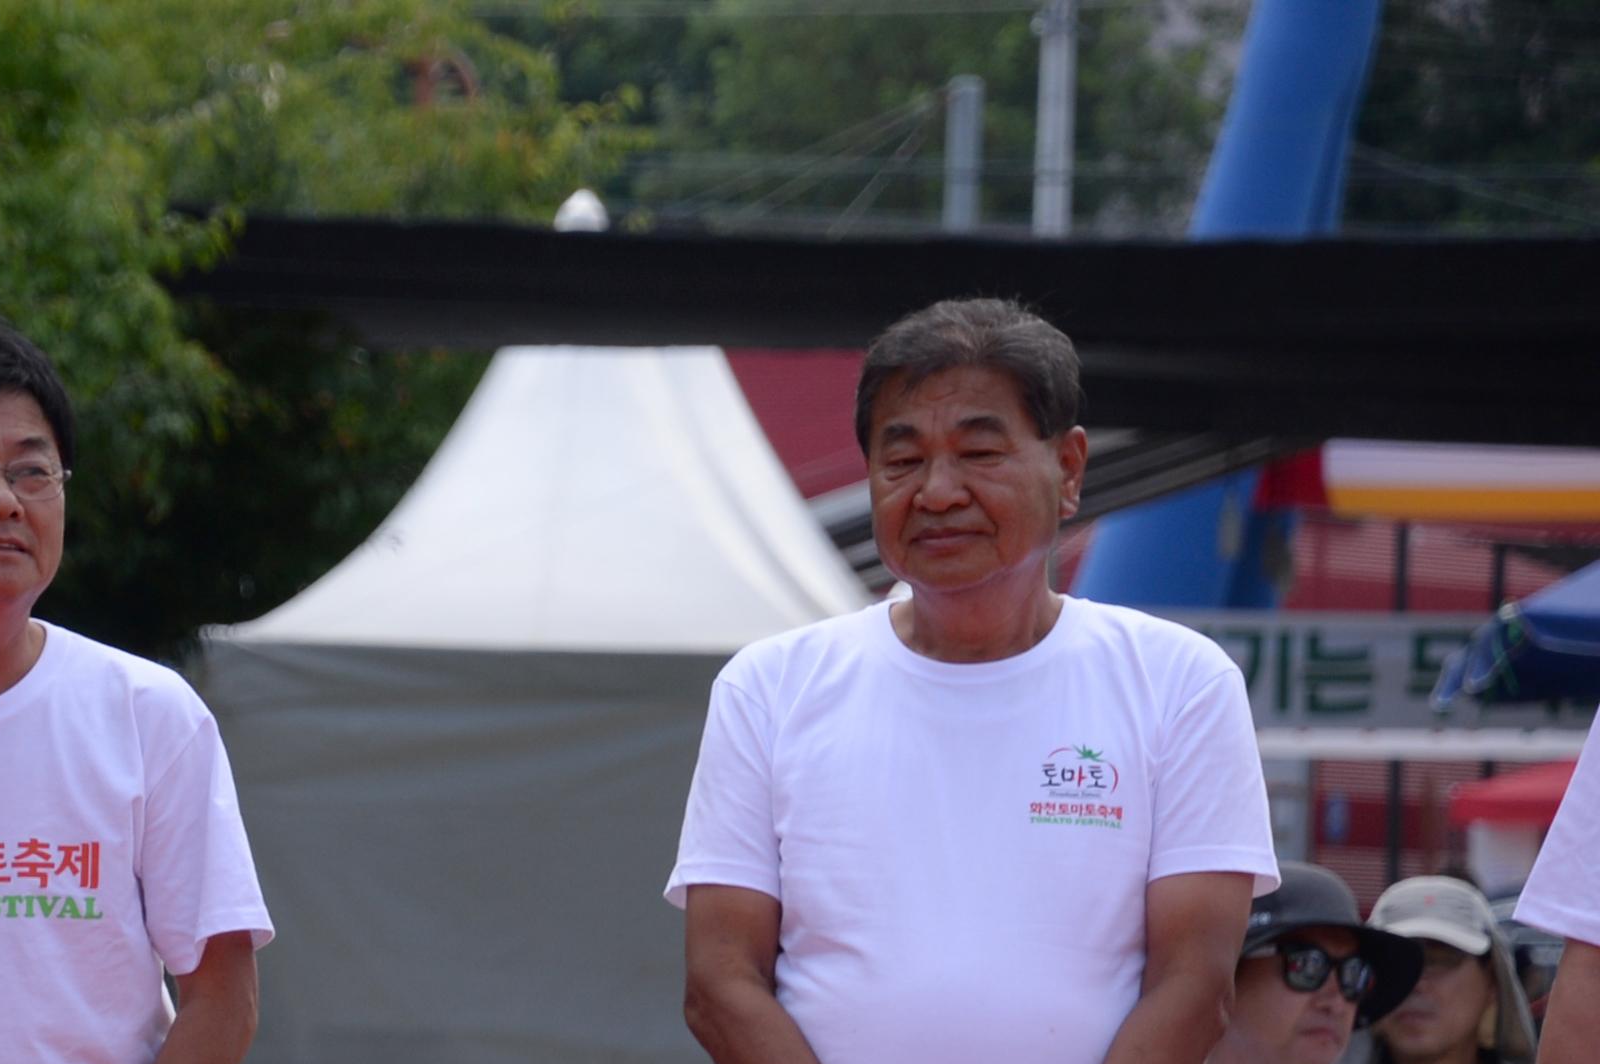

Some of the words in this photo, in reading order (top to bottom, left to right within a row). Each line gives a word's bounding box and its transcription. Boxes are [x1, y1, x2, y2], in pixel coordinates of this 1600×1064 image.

[1040, 763, 1108, 789] 토마토
[1030, 801, 1123, 820] 화천토마토축제
[1030, 816, 1073, 826] TOMATO
[1075, 817, 1123, 830] FESTIVAL
